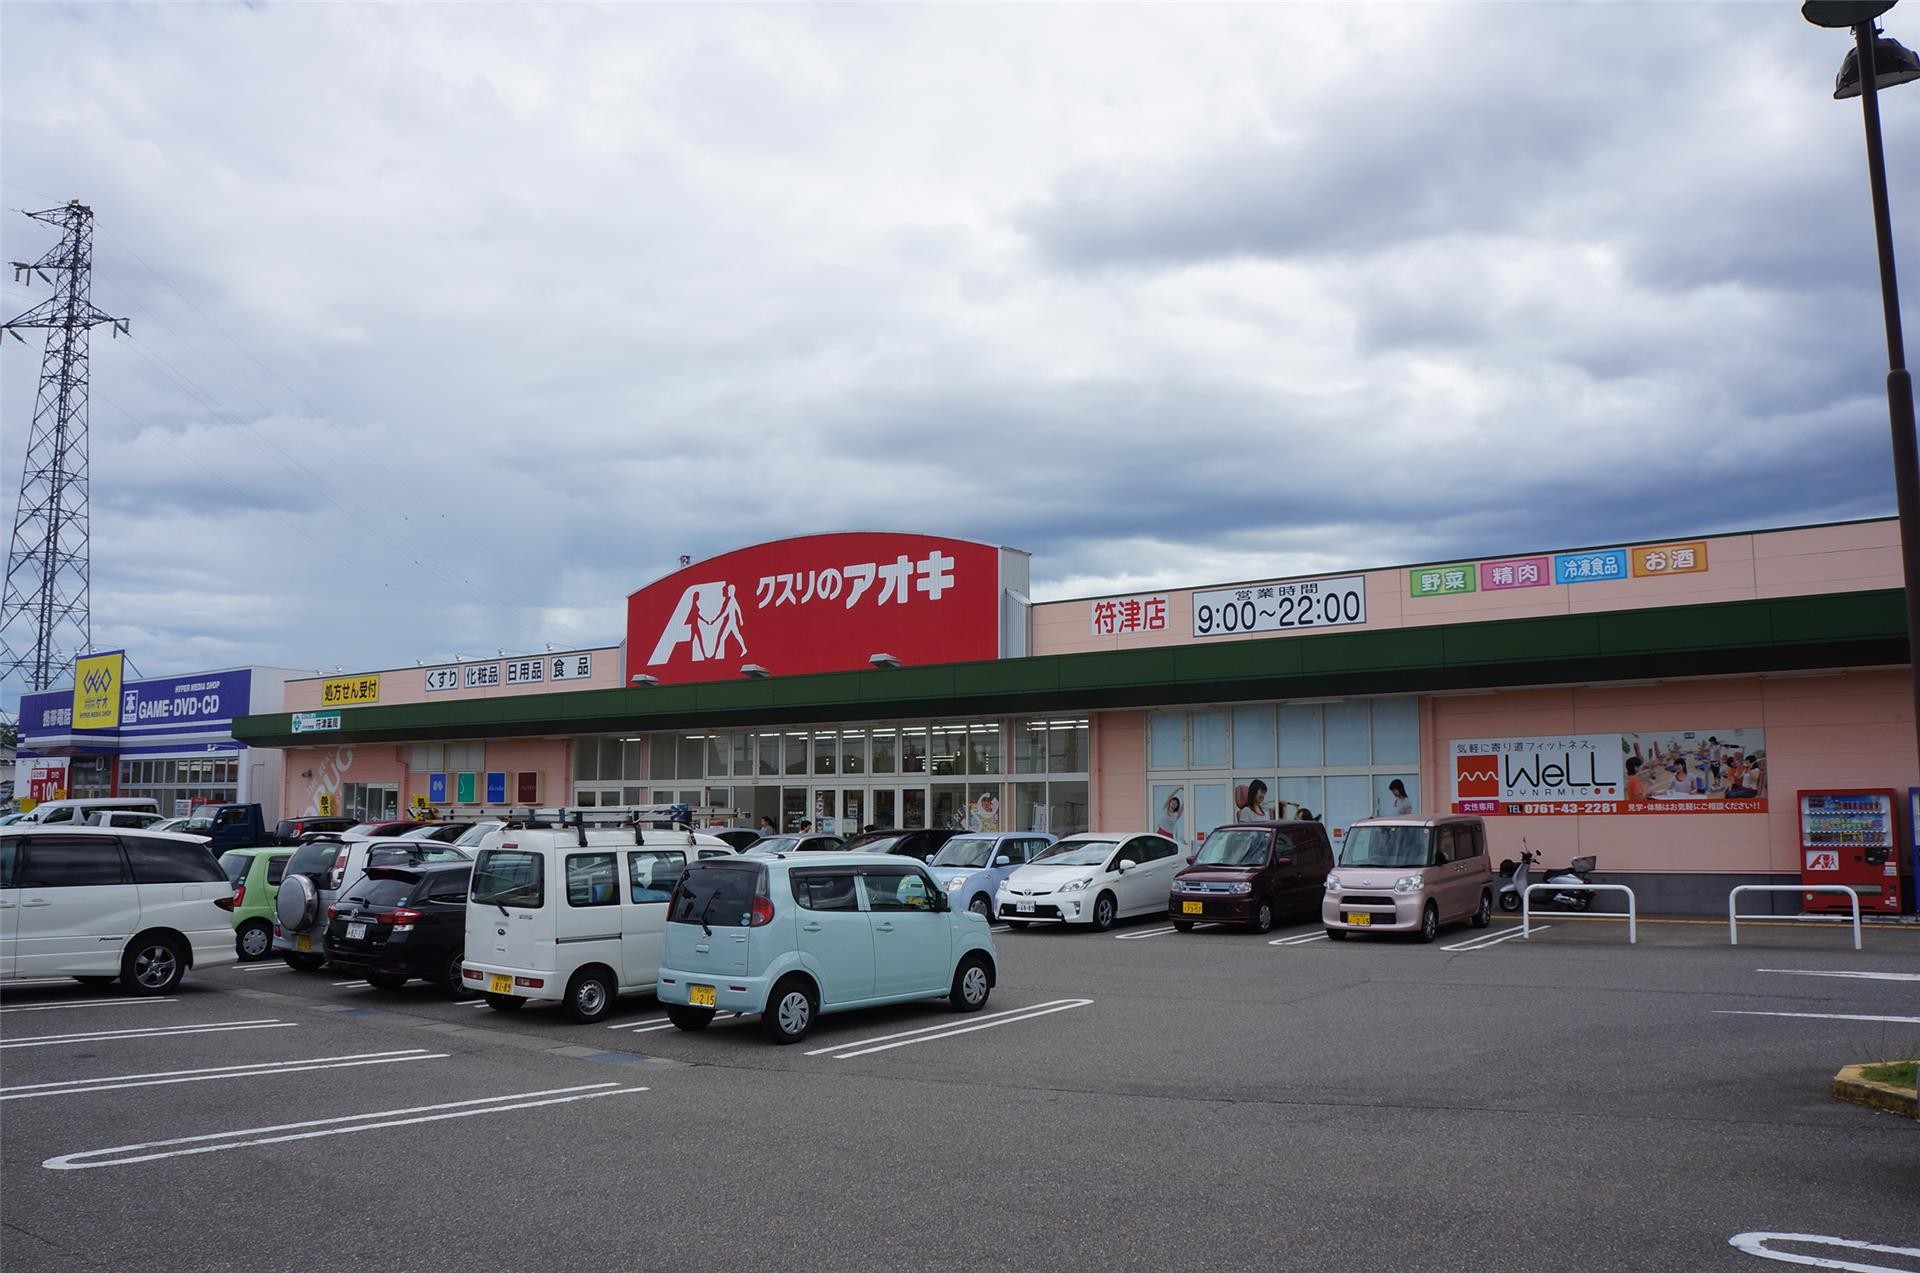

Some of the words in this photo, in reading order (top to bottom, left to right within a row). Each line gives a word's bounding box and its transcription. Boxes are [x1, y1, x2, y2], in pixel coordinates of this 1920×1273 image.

[1564, 556, 1619, 579] 冷凍食品
[1645, 549, 1694, 571] お酒
[756, 550, 955, 610] クスリのアオキ
[1420, 571, 1465, 592] 野菜
[1492, 563, 1538, 585] 精肉
[1235, 583, 1318, 601] 営業時間
[1094, 597, 1166, 635] 符津店
[466, 666, 498, 685] 化粧品
[508, 661, 542, 681] 日用品
[553, 657, 589, 678] 食品
[206, 681, 220, 690] SHOP
[427, 670, 457, 688] くすり
[325, 680, 377, 701] 処方せん受付
[1463, 802, 1495, 811] 女性専用
[1508, 805, 1522, 814] TEL
[1524, 803, 1617, 814] 0761-43-2281
